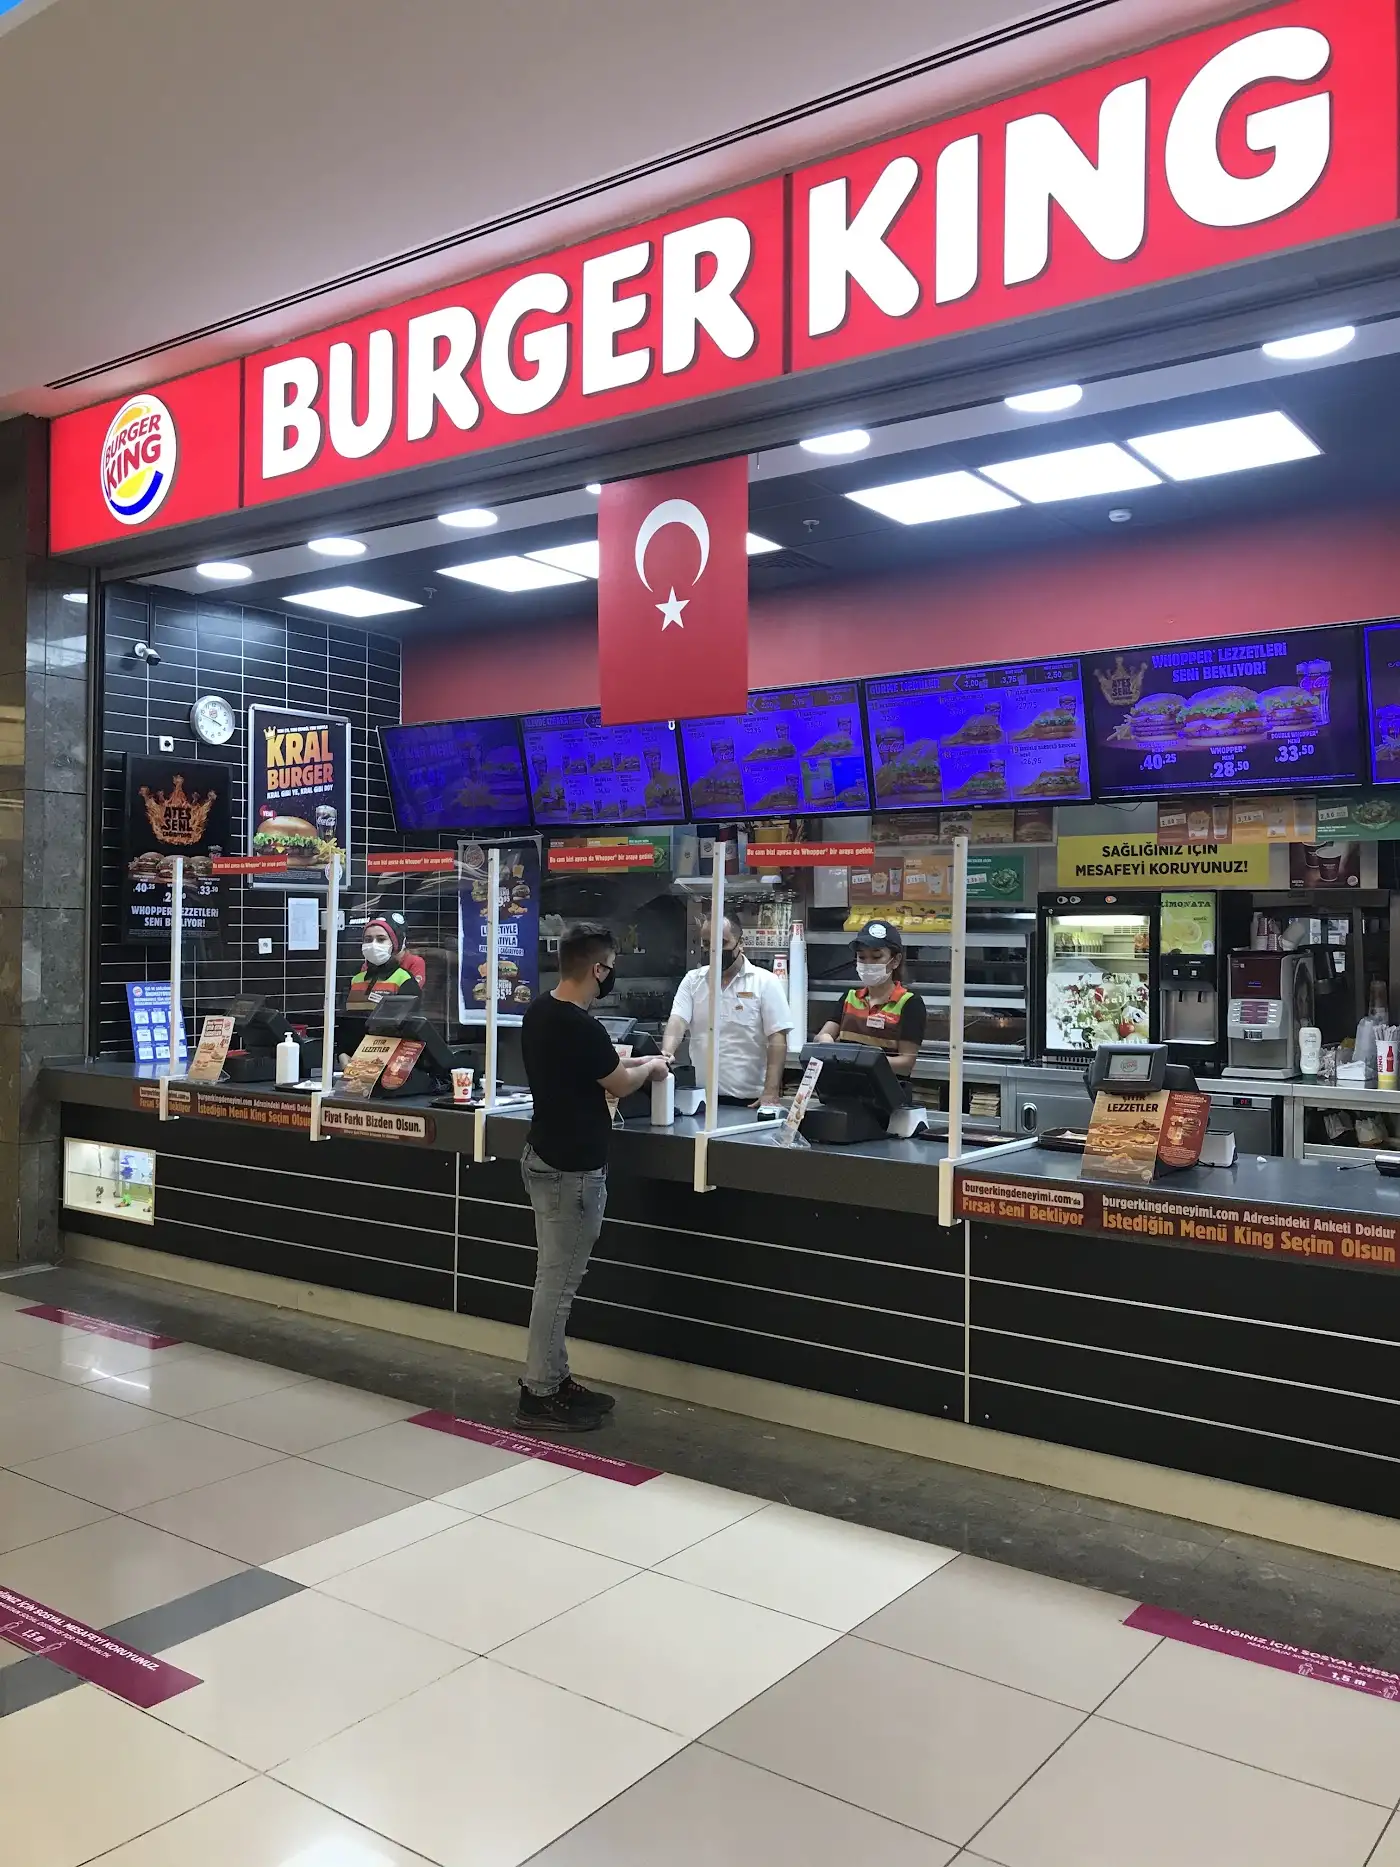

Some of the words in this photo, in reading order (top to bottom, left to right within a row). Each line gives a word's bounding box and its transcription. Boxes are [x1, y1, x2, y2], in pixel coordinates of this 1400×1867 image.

[261, 216, 756, 480] BURGER
[808, 26, 1330, 336] KING
[105, 414, 162, 469] BURGER
[106, 433, 162, 501] KING
[1172, 667, 1200, 683] SENİ
[1203, 661, 1267, 680] BEKLİYOR!
[267, 730, 333, 768] KRAL
[267, 763, 333, 790] BURGER
[1102, 842, 1183, 857] SAĞLIĞINIZ
[1075, 861, 1145, 876] MESAFEYİ
[1150, 860, 1248, 876] KORUYUNUZ!
[144, 917, 162, 926] SENİ
[181, 907, 218, 917] EZZETLERİ
[197, 1102, 227, 1117] İstediğin
[229, 1107, 248, 1119] Menü
[250, 1109, 267, 1123] King
[268, 1113, 290, 1126] Seçim
[324, 1110, 341, 1123] Fiyat
[344, 1112, 364, 1126] Farkı
[366, 1115, 393, 1129] Bizden
[396, 1118, 421, 1132] Olsun.
[1107, 1103, 1159, 1113] LEZZETLER
[962, 1197, 995, 1214] Fırsat
[998, 1202, 1025, 1217] Seni
[1029, 1205, 1084, 1226] Bekliyor
[1102, 1195, 1239, 1221] burgerkingdeneyimi.com
[1243, 1211, 1310, 1230] Adresindeki
[1313, 1218, 1351, 1234] Anketi
[1355, 1223, 1396, 1240] Doldur
[1102, 1207, 1173, 1235] İstediğin
[1180, 1219, 1228, 1241] Menü
[1234, 1226, 1274, 1249] King
[1280, 1232, 1333, 1256] Seçim
[1341, 1238, 1396, 1262] Olsun
[33, 1608, 66, 1627] SOSYAL
[63, 1621, 105, 1647] MESAFEYİ
[1192, 1619, 1268, 1644] SAĞLIĞINIZ
[1270, 1640, 1299, 1653] İÇİN
[1300, 1649, 1356, 1668] SOSYAL
[1247, 1641, 1291, 1656] MAINTAIN
[1292, 1653, 1325, 1667] SOCIAL
[1327, 1663, 1374, 1679] DISTANCE
[1331, 1671, 1352, 1683] 1,5
[1353, 1679, 1367, 1687] m
